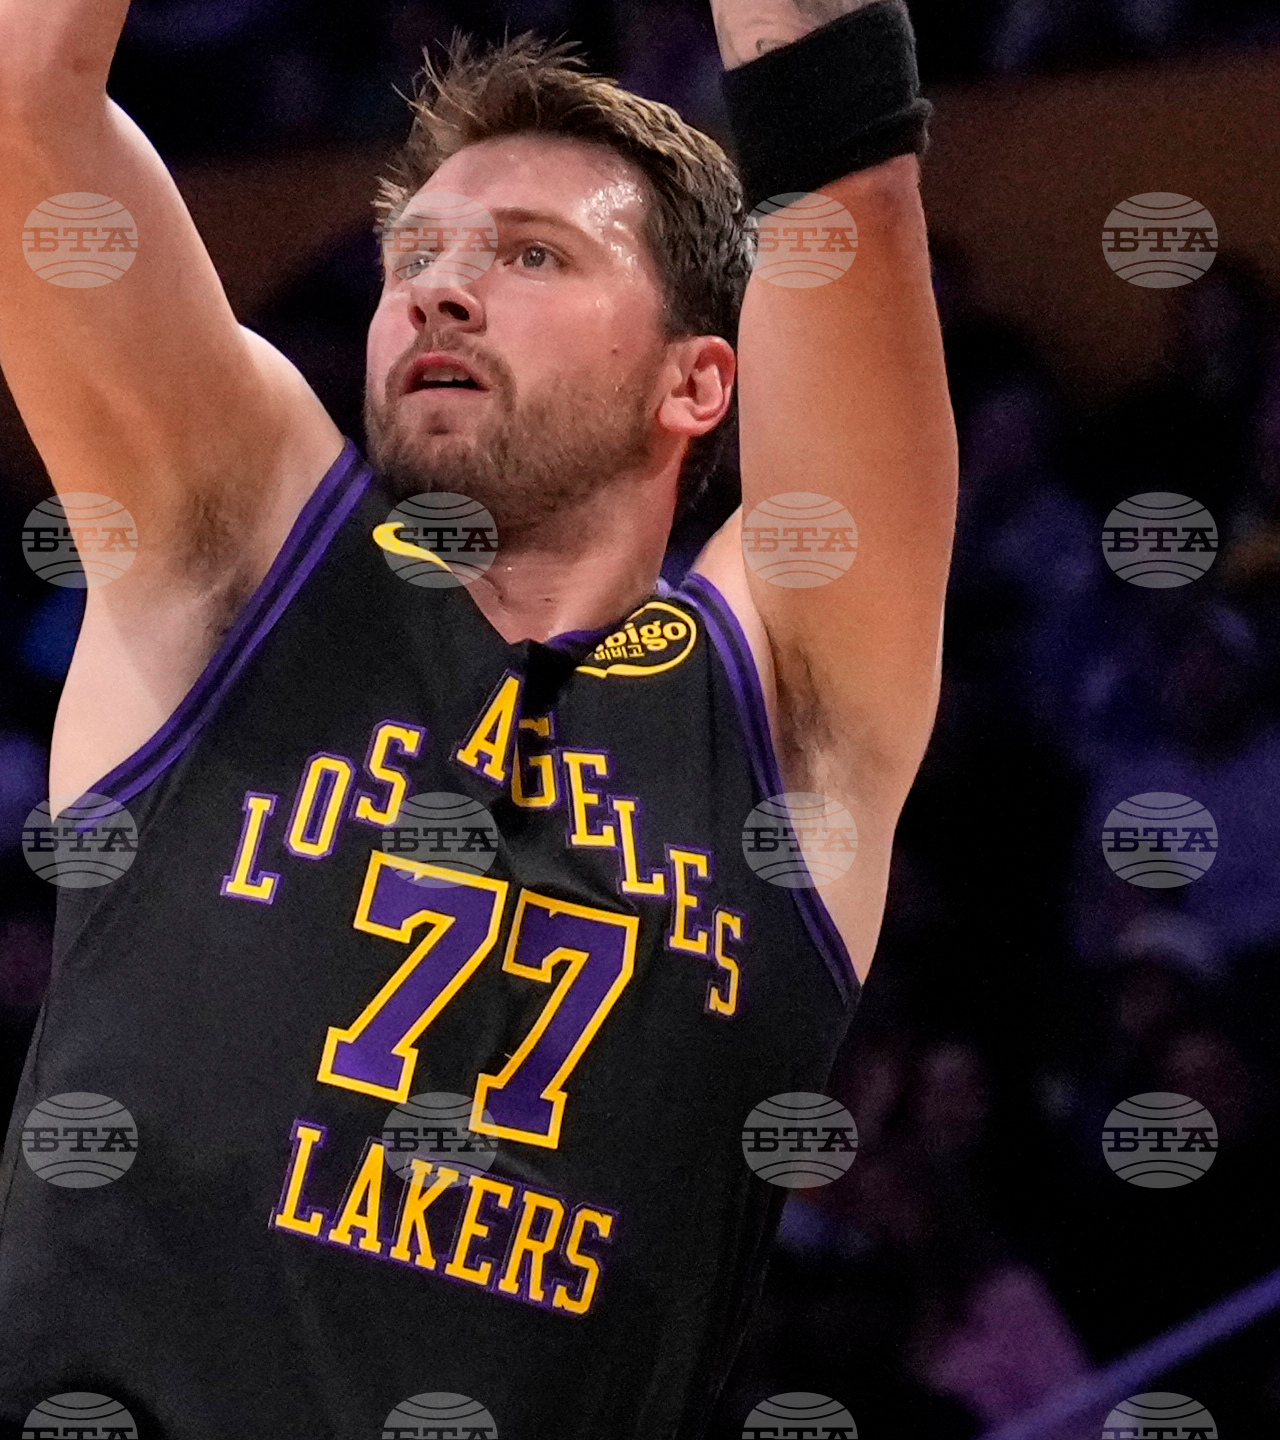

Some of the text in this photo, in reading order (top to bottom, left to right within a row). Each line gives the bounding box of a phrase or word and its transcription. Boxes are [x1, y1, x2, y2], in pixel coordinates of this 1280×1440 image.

[220, 669, 748, 1021] LOS AGELES
[316, 848, 640, 1150] 77
[270, 1118, 619, 1320] LAKERS
